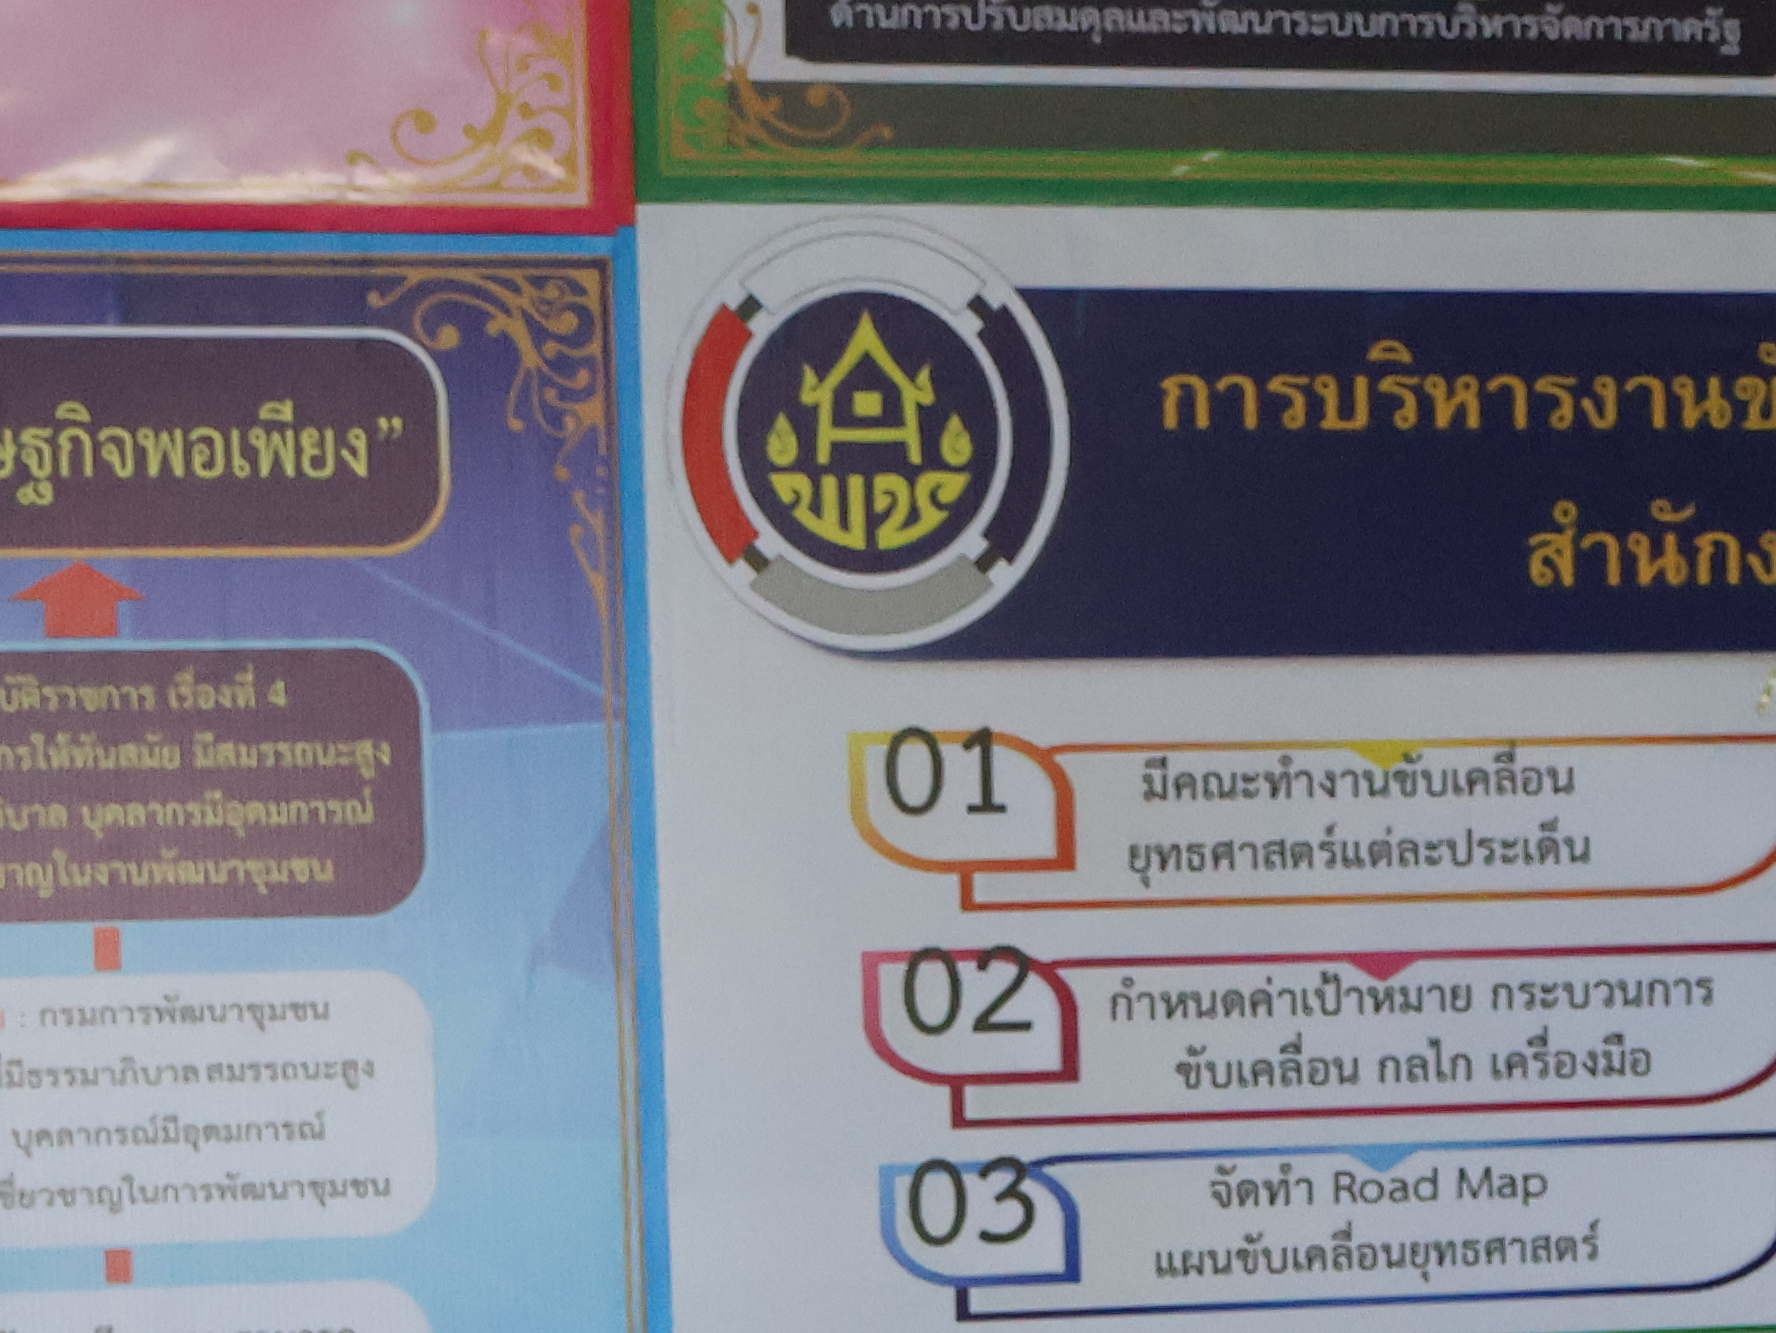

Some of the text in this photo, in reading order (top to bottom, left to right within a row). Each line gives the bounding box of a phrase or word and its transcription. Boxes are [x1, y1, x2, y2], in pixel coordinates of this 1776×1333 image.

[267, 680, 288, 707] 4
[886, 725, 1008, 814] 01
[1140, 746, 1576, 803] มีคณะทำงานขับเคลื่อน
[1127, 817, 1592, 889] ยุทธศาสตร์แต่ละประเด็น
[39, 992, 330, 1033] กรมการพัฒนาชุมชน
[902, 944, 1035, 1036] 02
[1108, 970, 1715, 1026] กำหนดค่าเป้าหมาย กระบวนการ
[1174, 1026, 1652, 1093] ขับเคลื่อน กลไก เครื่องมือ
[907, 1156, 1037, 1247] 03
[1209, 1164, 1549, 1211] จัดทำ Road Map
[1154, 1219, 1600, 1284] แผนขับเคลื่อนยุทธศาสตร์
